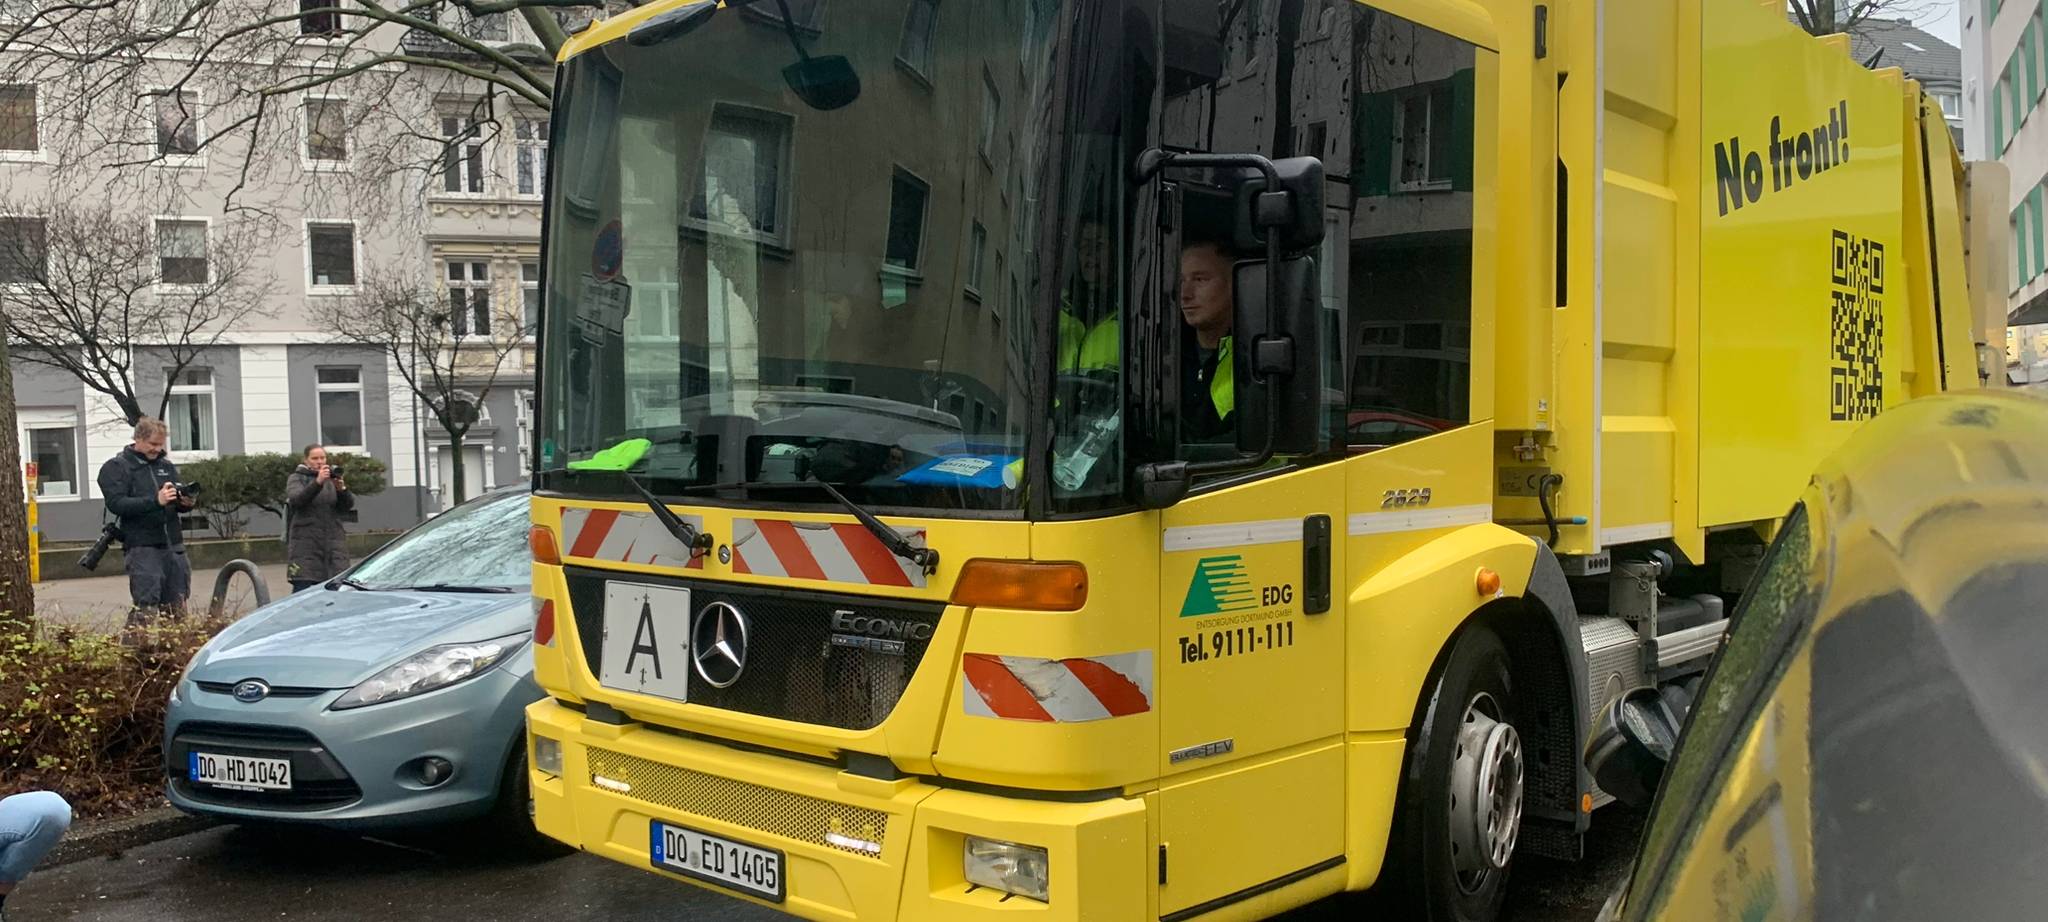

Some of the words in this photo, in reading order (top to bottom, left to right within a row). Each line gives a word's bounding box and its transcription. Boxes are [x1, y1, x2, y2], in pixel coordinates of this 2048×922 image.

[1714, 136, 1763, 217] No
[1769, 99, 1849, 192] front!
[1381, 487, 1431, 508] 2629
[1262, 584, 1293, 607] EDG
[1196, 616, 1239, 629] ENTSORGUNG
[1240, 611, 1273, 623] DORTMUND
[625, 602, 662, 680] A
[1179, 633, 1209, 664] Tel.
[1212, 621, 1293, 658] 9111-111
[199, 756, 216, 779] DO
[226, 758, 245, 782] HD
[249, 761, 288, 785] 1042
[665, 829, 687, 863] DO
[702, 839, 724, 874] ED
[730, 847, 776, 889] 1405
